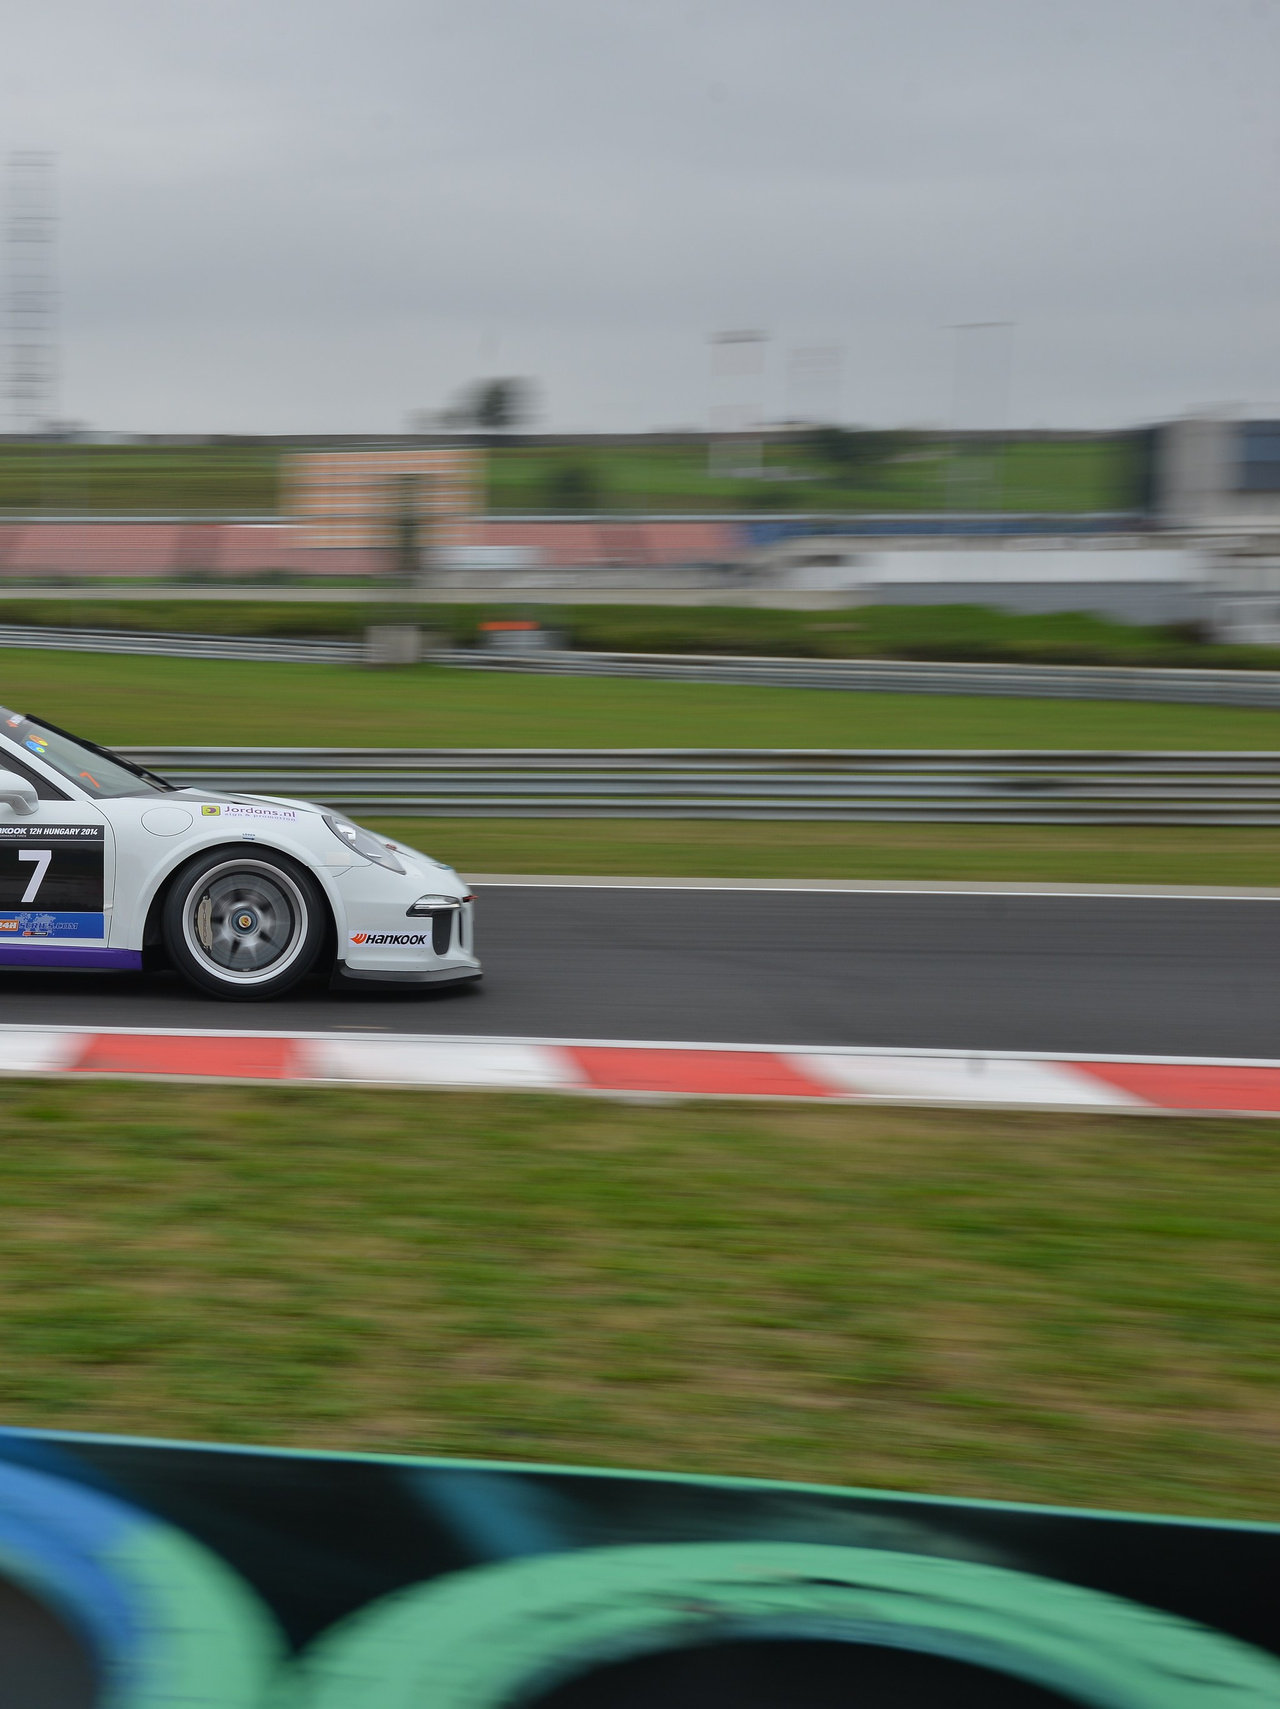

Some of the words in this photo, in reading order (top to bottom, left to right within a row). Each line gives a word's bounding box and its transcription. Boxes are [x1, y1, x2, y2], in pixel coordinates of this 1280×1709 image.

[225, 806, 296, 817] Jordans.nl
[43, 828, 80, 836] HUNGARY
[81, 828, 98, 836] 2014
[18, 849, 52, 903] 7
